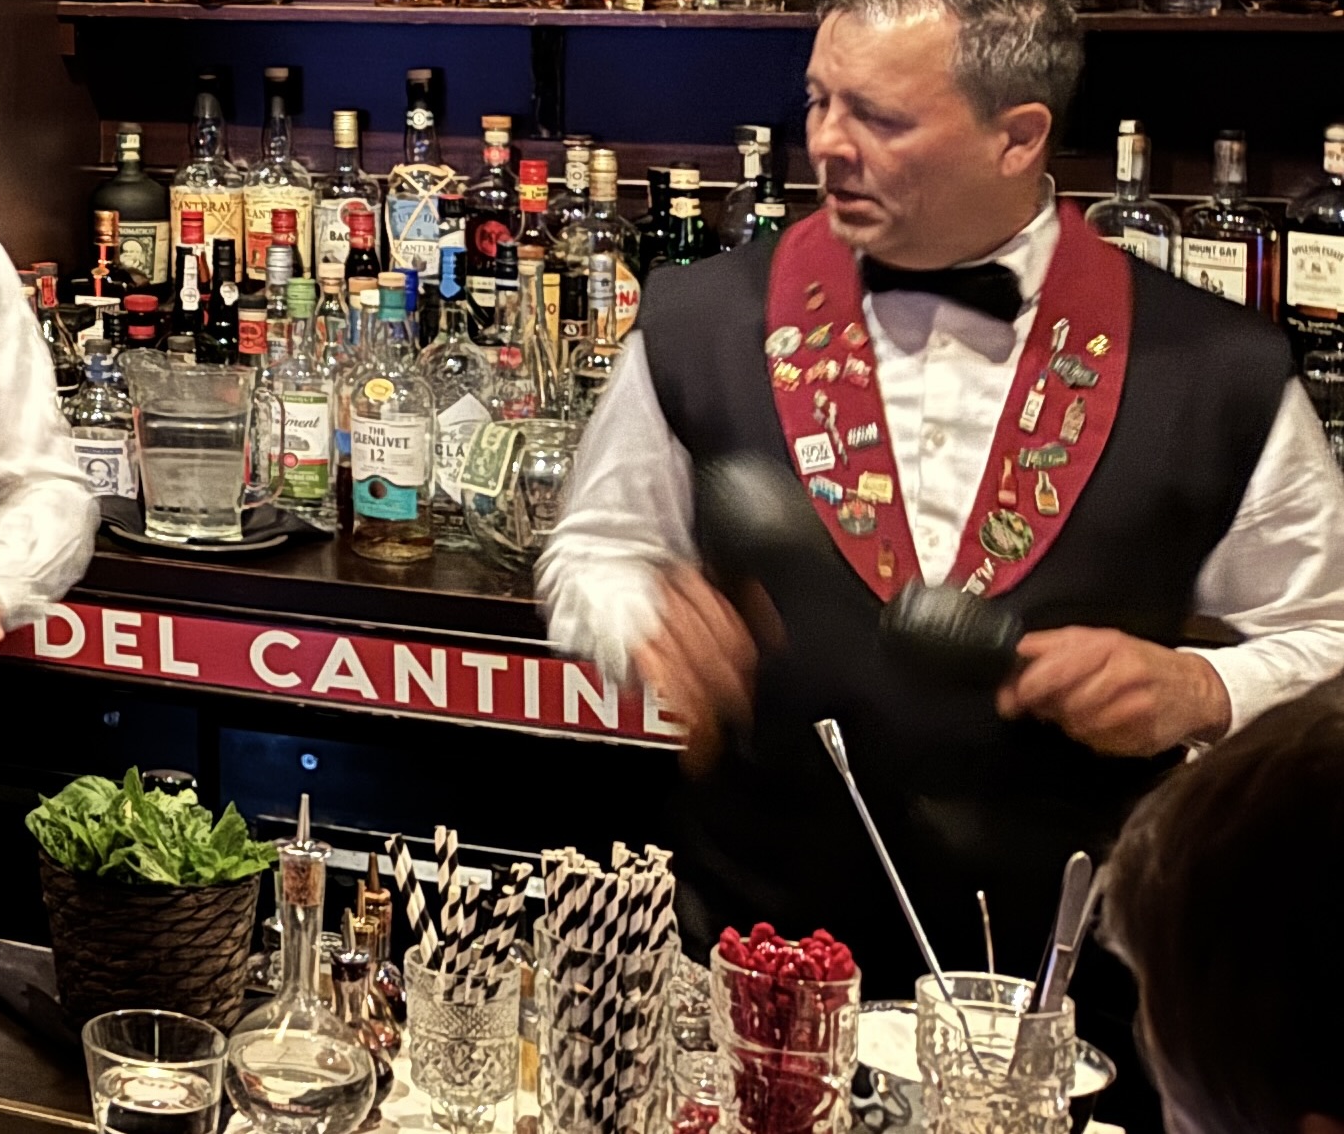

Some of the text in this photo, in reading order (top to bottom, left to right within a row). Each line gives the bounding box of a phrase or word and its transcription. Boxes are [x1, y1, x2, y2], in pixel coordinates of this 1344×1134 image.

[174, 200, 232, 212] ANTERAY
[1189, 244, 1237, 257] MOUNT GAY
[285, 415, 320, 429] ment
[369, 426, 385, 435] THE
[354, 433, 410, 449] GLENLIVET
[370, 448, 385, 462] 12
[435, 445, 464, 458] CLA
[33, 603, 200, 677] DEL
